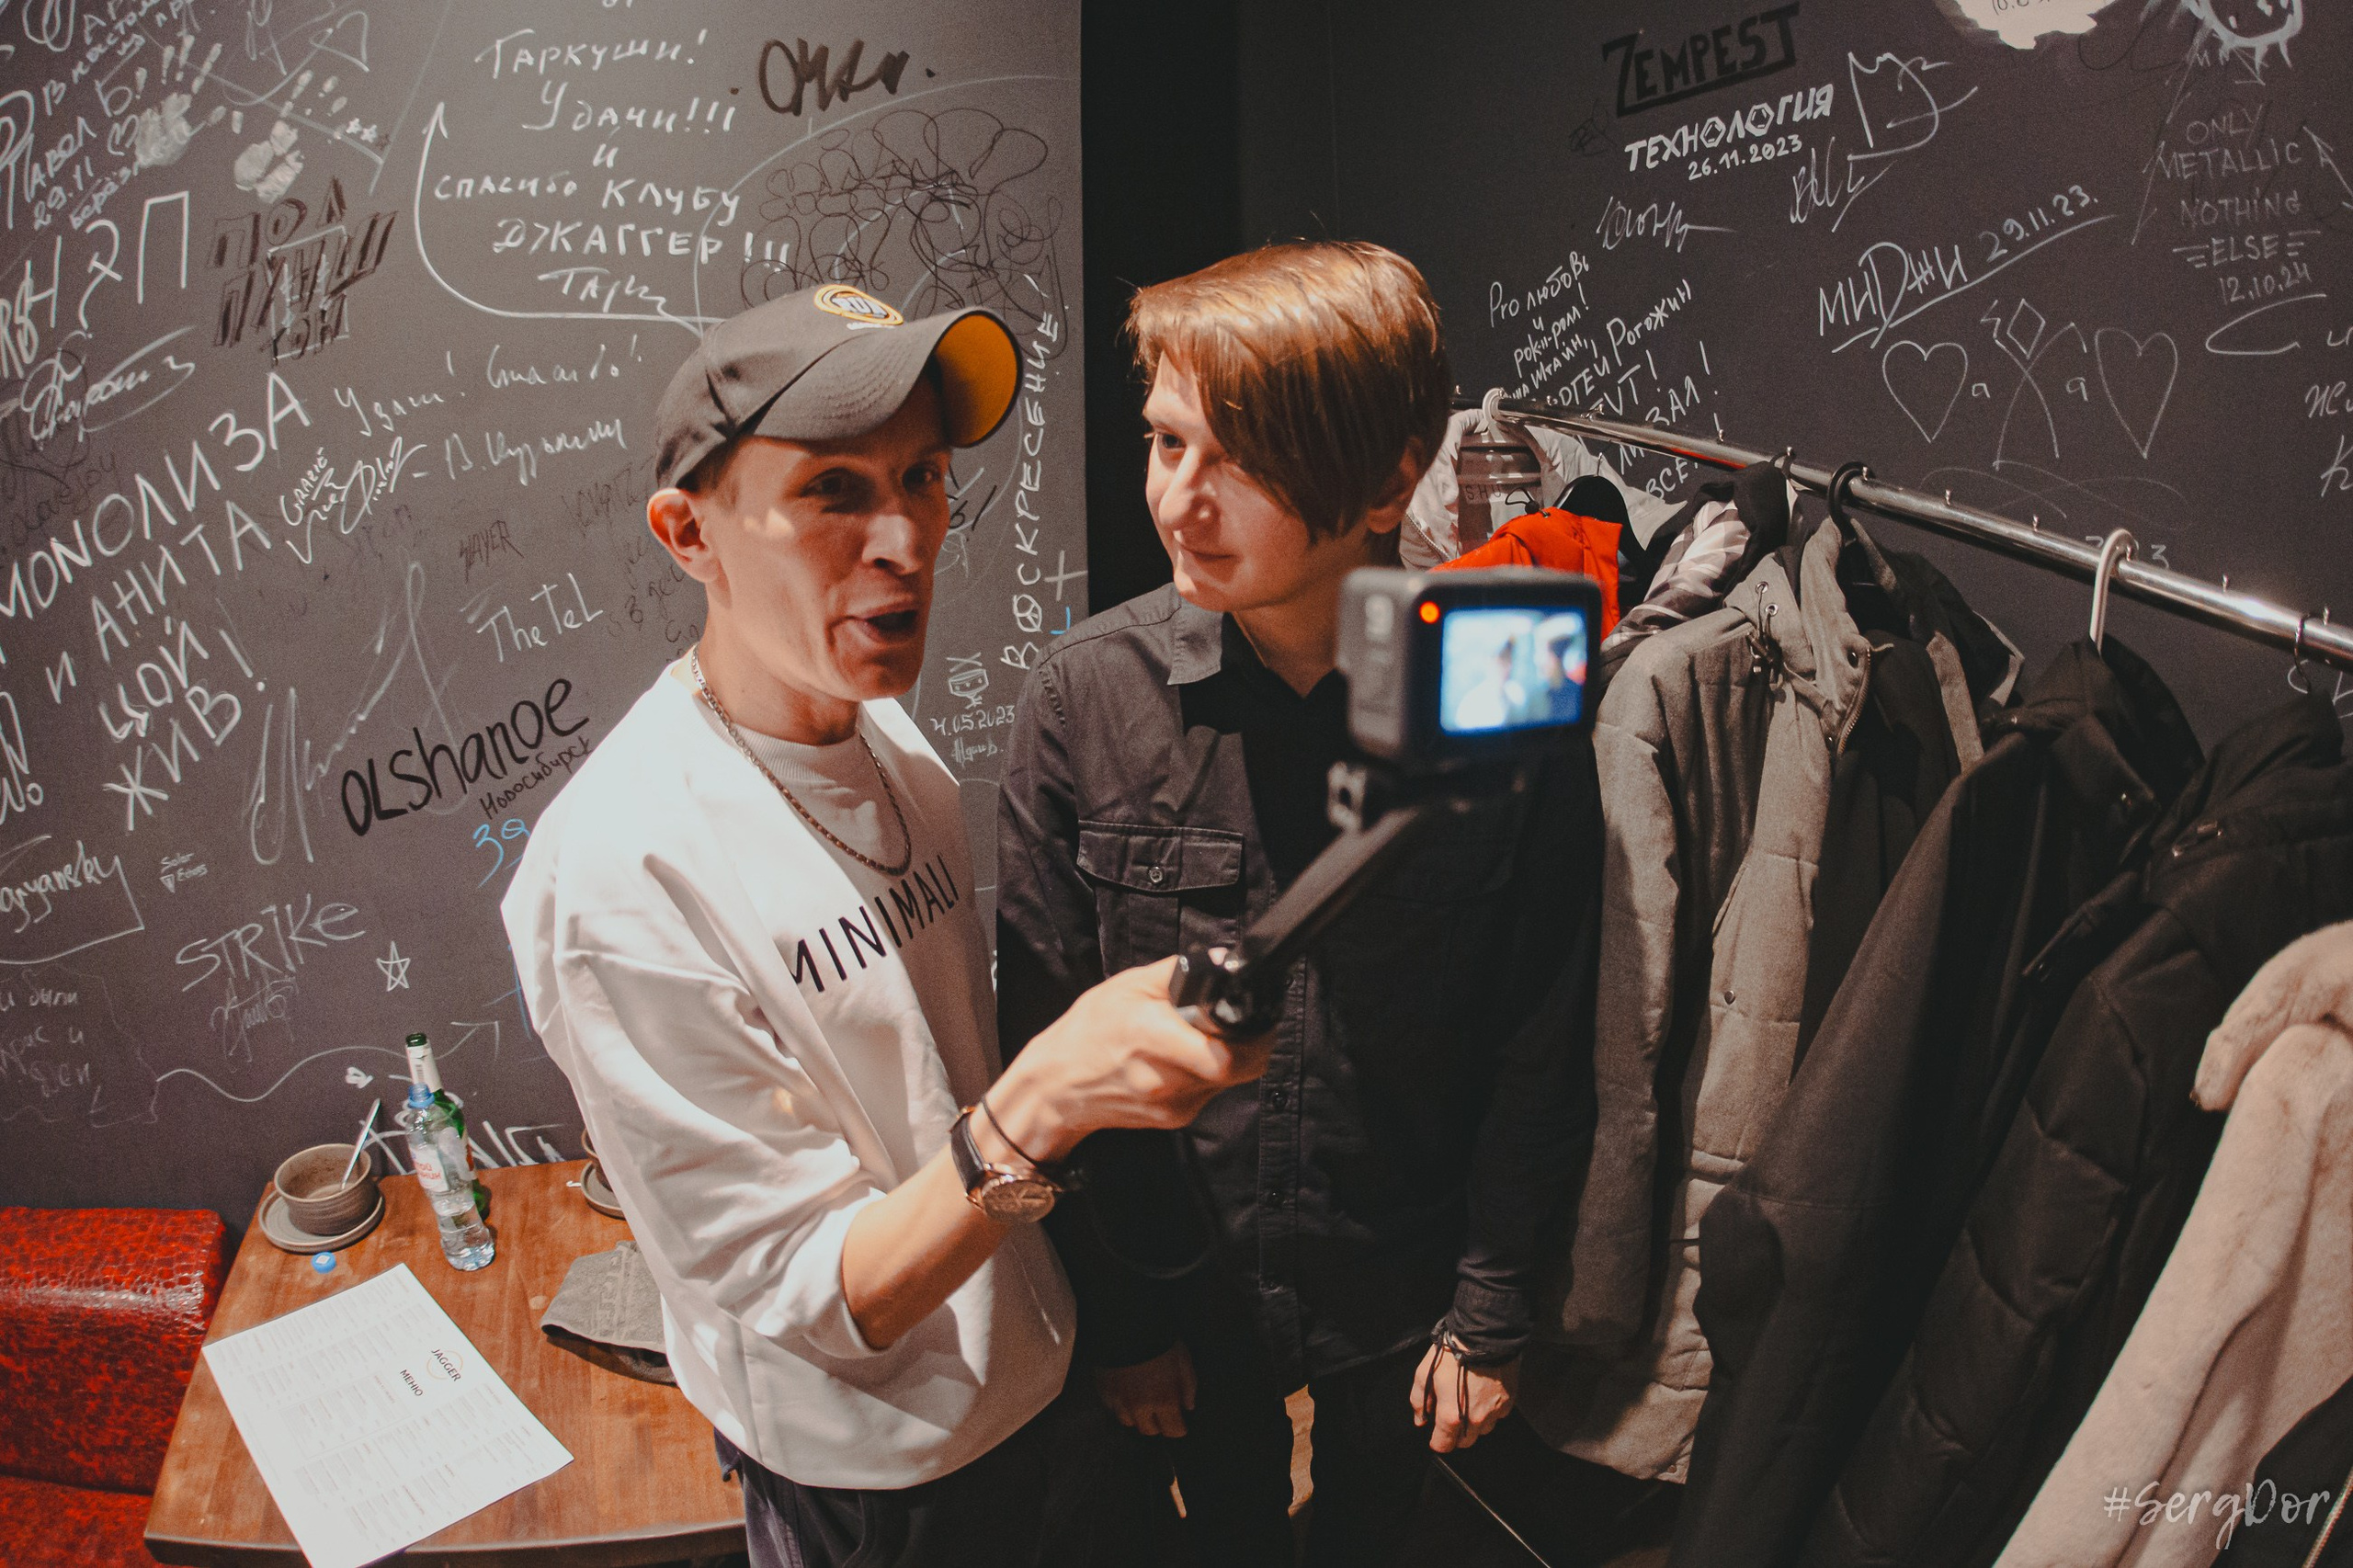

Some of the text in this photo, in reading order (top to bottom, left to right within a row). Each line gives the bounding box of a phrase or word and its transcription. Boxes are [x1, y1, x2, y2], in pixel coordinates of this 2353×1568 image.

[1624, 83, 1835, 172] ТЕХНОЛОГИЯ
[1688, 134, 1802, 180] 26.11.2023
[2211, 233, 2279, 267] ELSE
[431, 1348, 461, 1381] JAGGER
[399, 1369, 424, 1396] МЕНЮ
